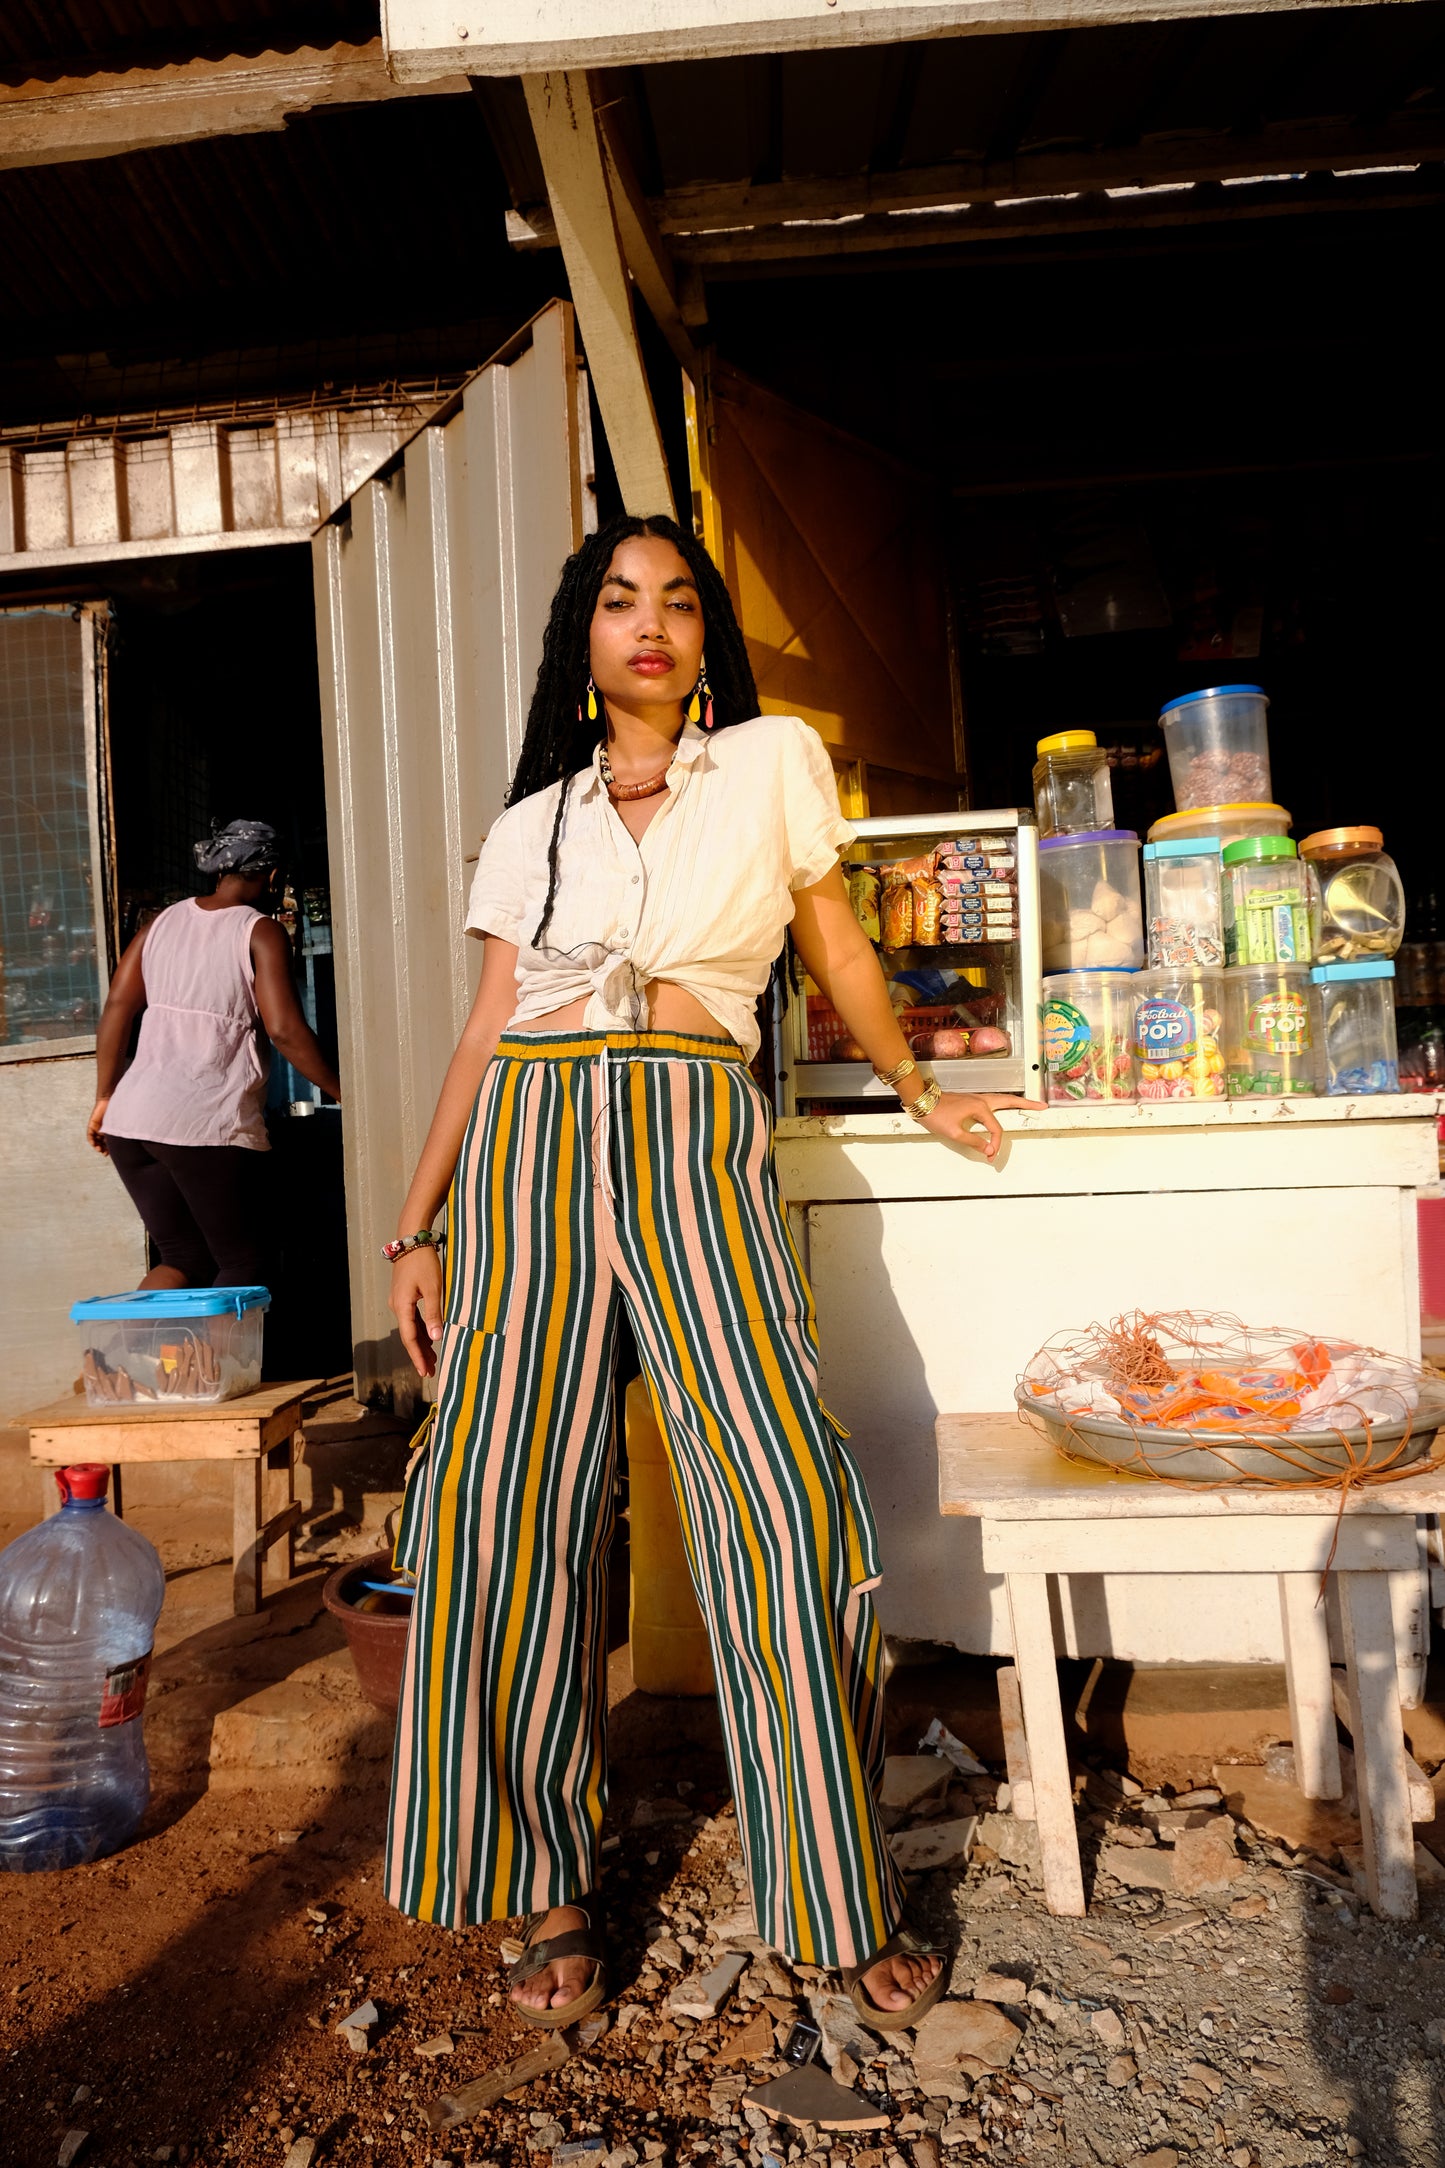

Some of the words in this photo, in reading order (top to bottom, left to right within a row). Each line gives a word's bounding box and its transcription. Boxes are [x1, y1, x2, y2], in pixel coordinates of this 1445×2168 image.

[1136, 1009, 1188, 1023] Football
[1260, 1016, 1306, 1033] POP
[1139, 1022, 1183, 1040] POP
